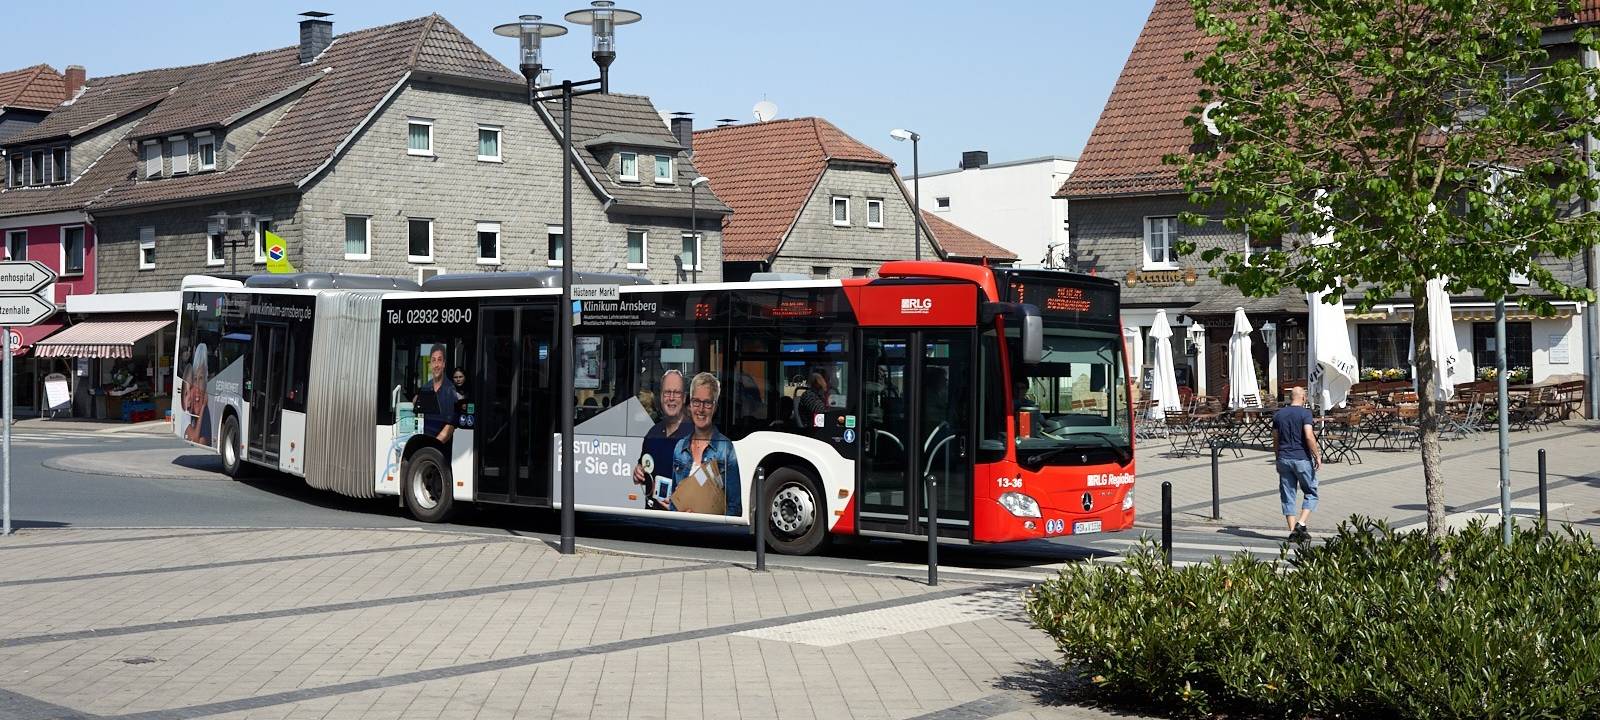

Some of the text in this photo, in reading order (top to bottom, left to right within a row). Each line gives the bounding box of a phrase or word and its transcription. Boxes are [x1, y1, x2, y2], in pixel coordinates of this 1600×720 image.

[573, 287, 616, 297] Hüstener Markt
[583, 300, 657, 313] Klinikum Arnsberg
[910, 298, 932, 309] RLG
[249, 302, 312, 322] www.klinikum-arnsberg.de
[386, 308, 472, 324] Tel. 02932 980-0
[573, 440, 626, 456] STUNDEN
[585, 456, 608, 475] Sie
[612, 458, 631, 477] da
[997, 477, 1023, 488] 13-36
[1094, 473, 1135, 488] RLG RegioBus
